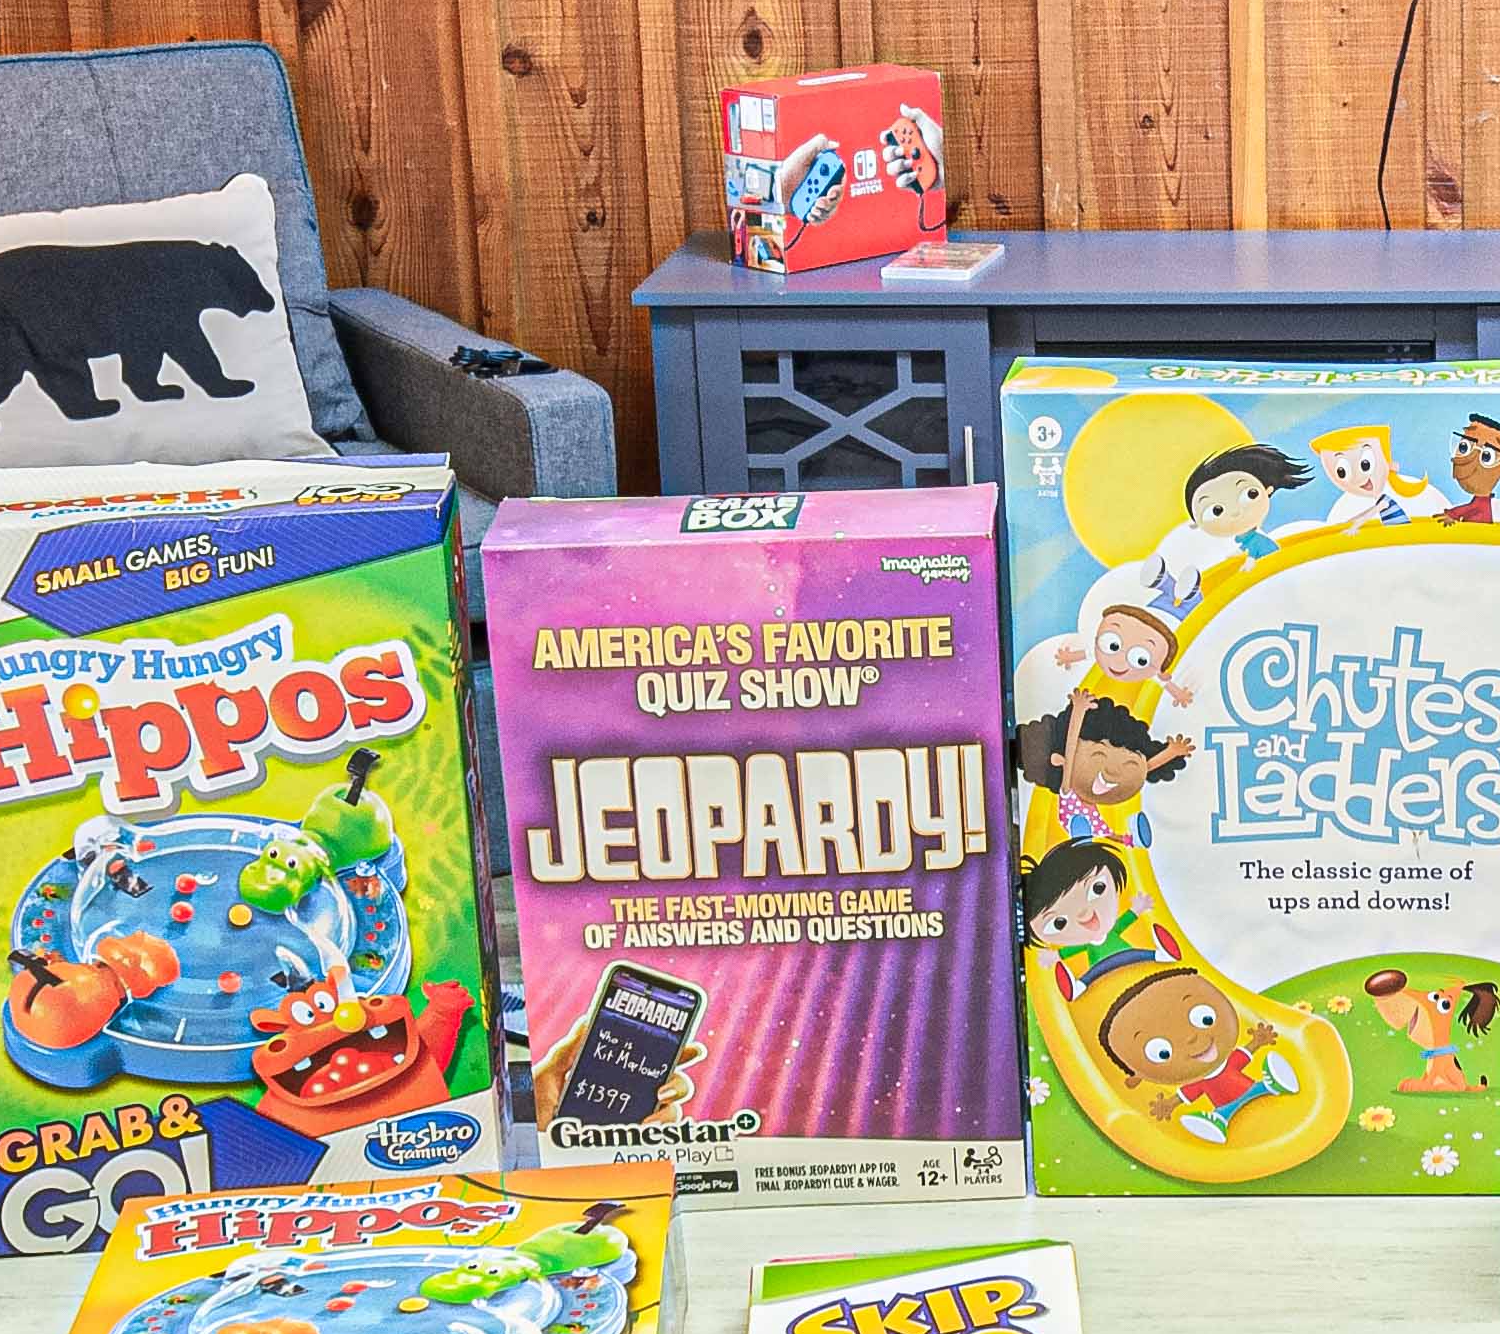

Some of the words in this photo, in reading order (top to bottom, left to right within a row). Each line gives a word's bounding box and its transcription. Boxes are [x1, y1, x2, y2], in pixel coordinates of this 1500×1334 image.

[686, 508, 792, 531] BOX
[35, 557, 120, 595] SMALL
[125, 535, 218, 570] GAMES,
[164, 561, 210, 591] BIG
[217, 545, 275, 580] FUN!
[132, 625, 283, 680] Hungry
[532, 623, 753, 670] AMERICA'S
[762, 616, 953, 663] FAVORITE
[636, 669, 731, 717] QUIZ
[1255, 733, 1306, 762] and
[526, 744, 988, 883] JEOPARDY!
[1240, 860, 1285, 881] The
[1292, 859, 1372, 881] classic
[1378, 865, 1442, 888] game
[1448, 859, 1474, 880] of
[610, 897, 660, 923] THE
[665, 891, 834, 921] FAST-MOVING
[839, 888, 913, 915] GAME
[1268, 893, 1310, 913] ups
[1317, 890, 1361, 911] and
[1367, 890, 1453, 911] downs!
[584, 923, 618, 949] OF
[624, 920, 745, 948] ANSWERS
[750, 918, 801, 943] AND
[806, 912, 944, 945] QUESTIONS
[604, 987, 687, 1032] JEOPARDY!
[159, 1096, 202, 1139] &
[370, 1120, 474, 1155] Hasbro
[388, 1141, 462, 1162] Gaming
[964, 1174, 1002, 1185] PLAYERS
[154, 1192, 297, 1221] Hungry
[301, 1183, 437, 1211] Hungry
[145, 1198, 506, 1258] Hippos
